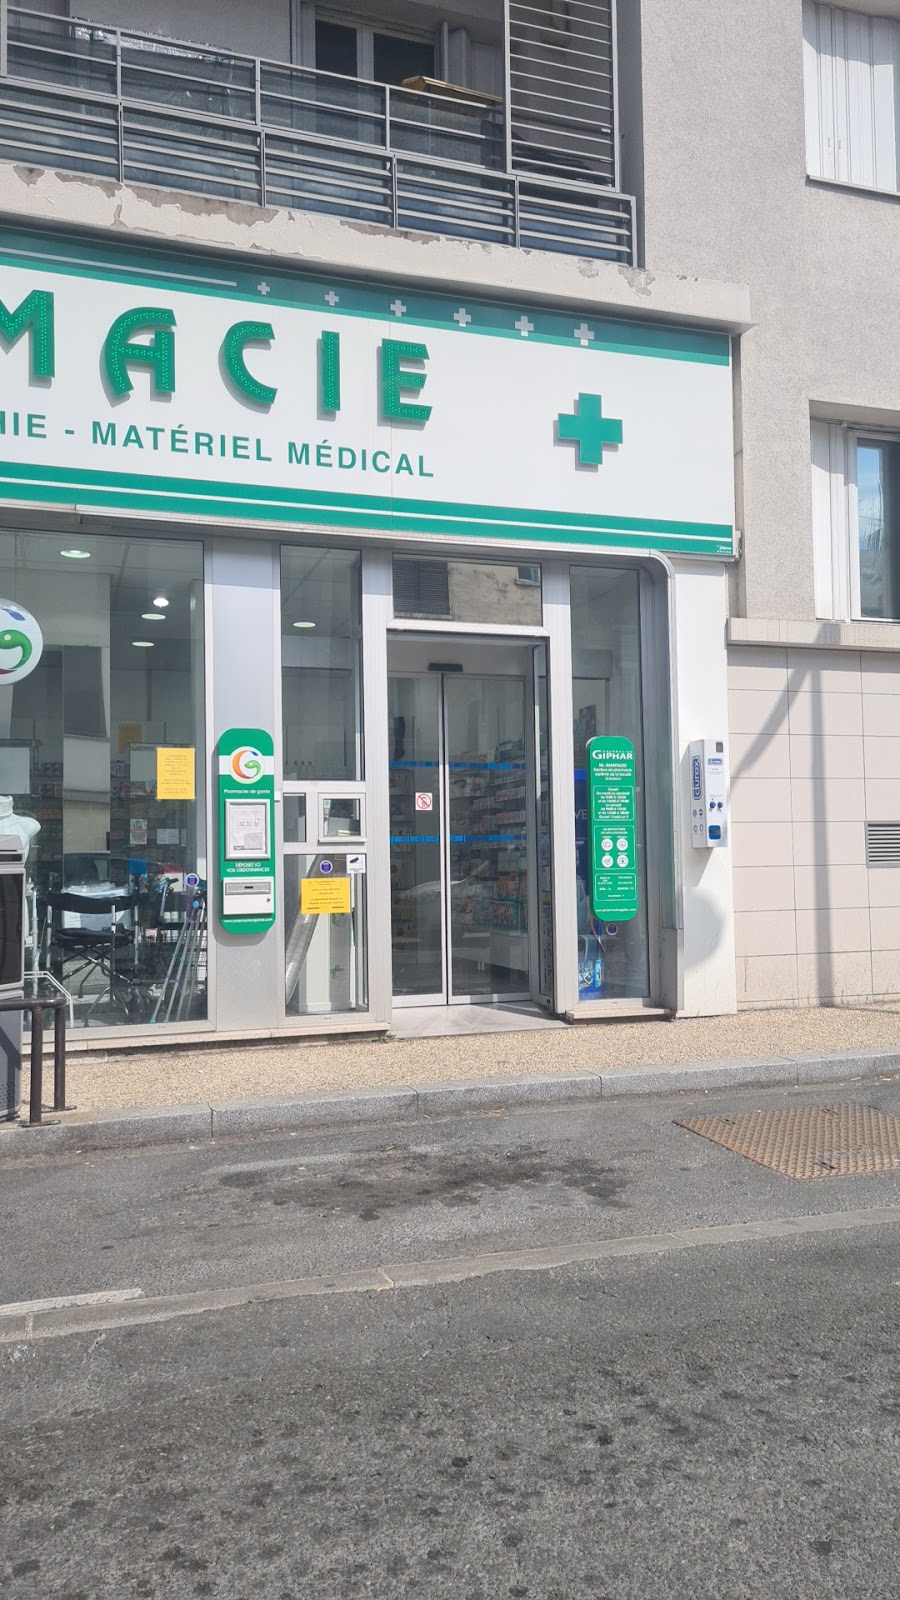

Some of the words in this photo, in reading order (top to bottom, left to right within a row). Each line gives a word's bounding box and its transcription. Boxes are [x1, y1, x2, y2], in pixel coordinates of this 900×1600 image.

[0, 411, 47, 439] IE
[92, 420, 273, 462] MATÉRIEL
[288, 440, 435, 477] MÉDICAL
[693, 760, 701, 797] durex
